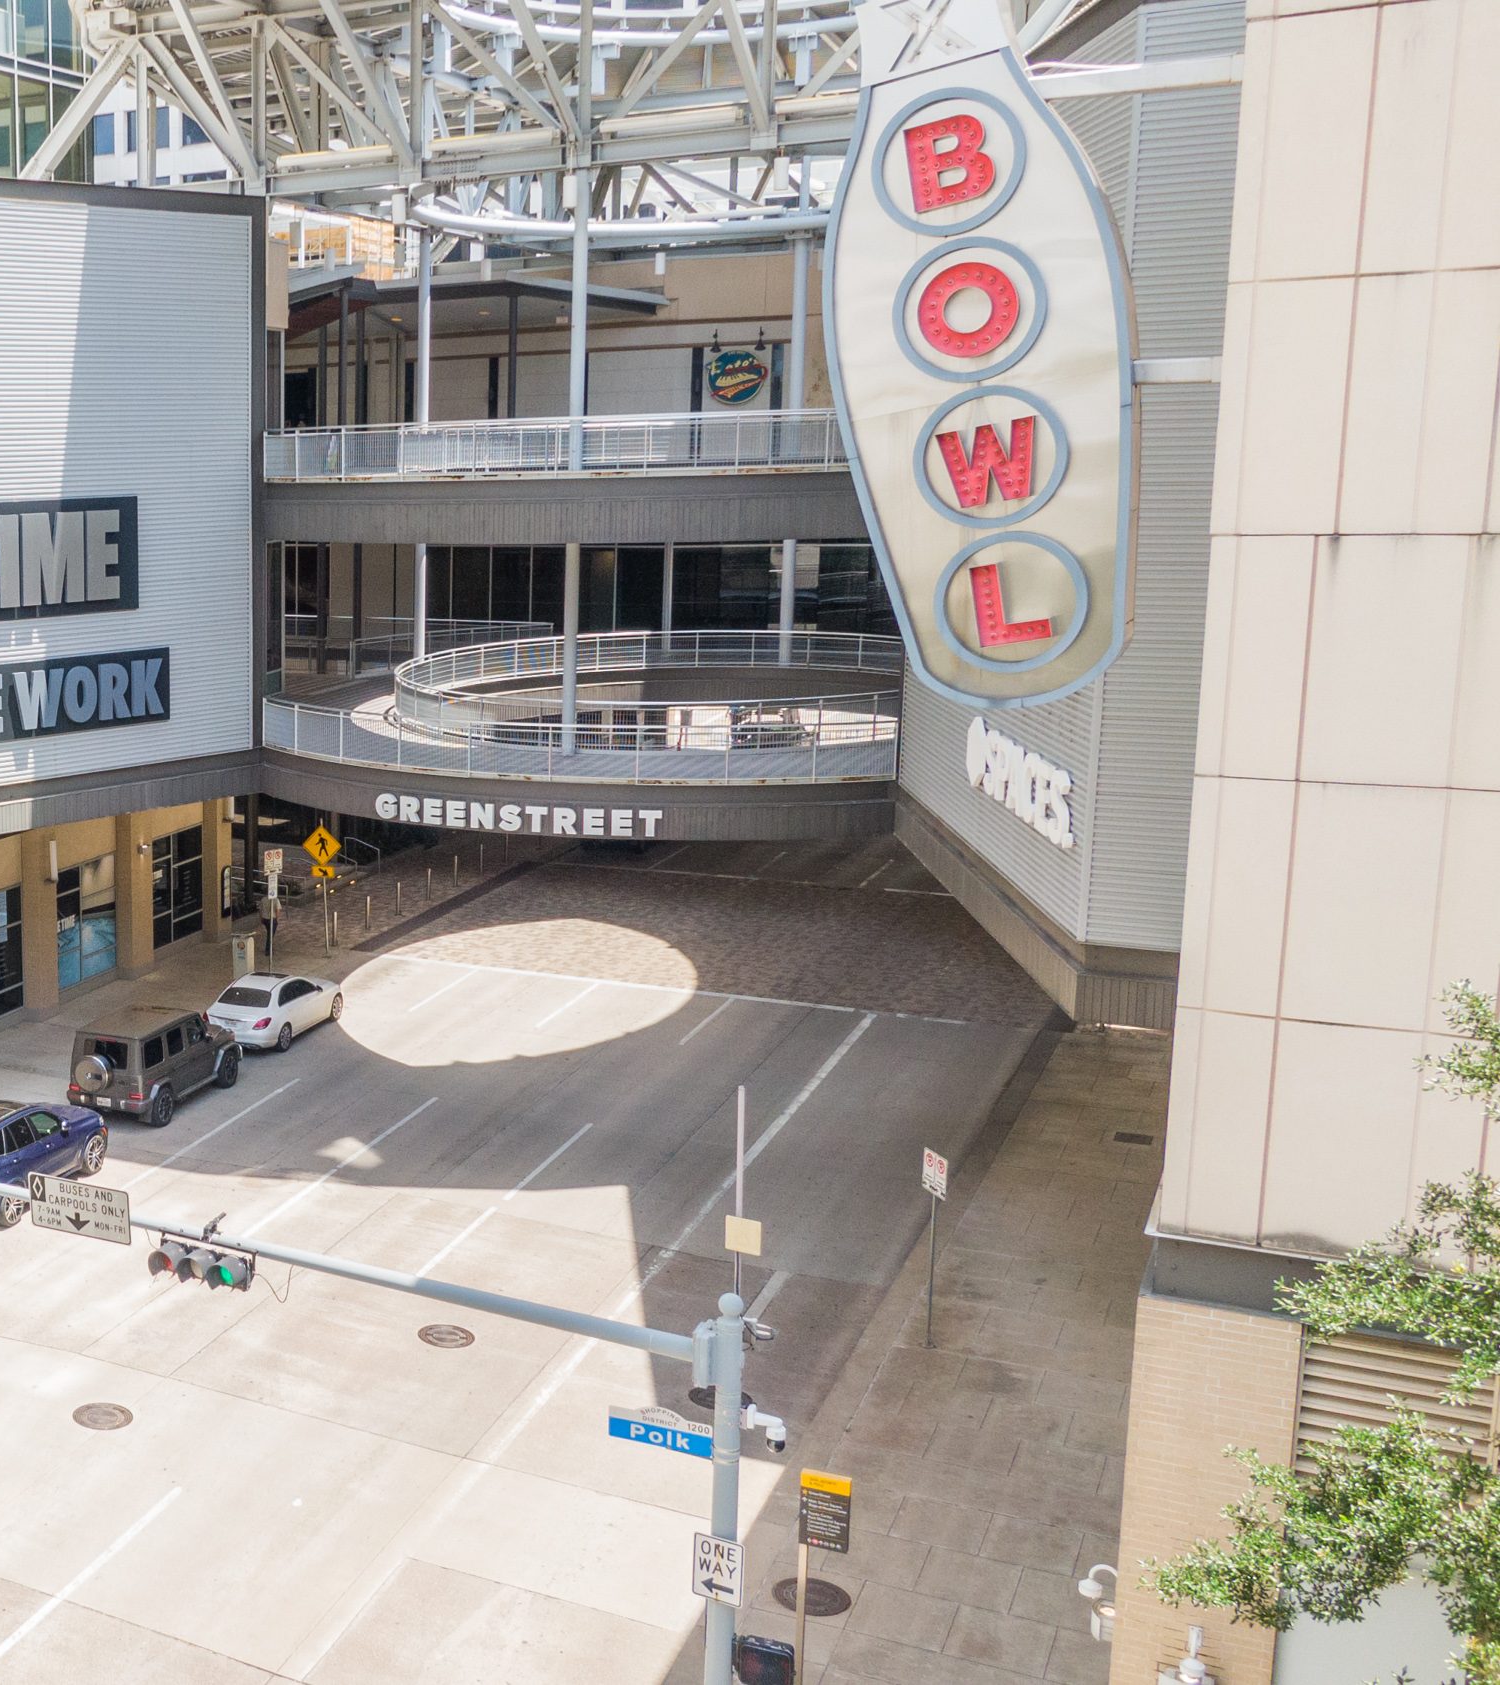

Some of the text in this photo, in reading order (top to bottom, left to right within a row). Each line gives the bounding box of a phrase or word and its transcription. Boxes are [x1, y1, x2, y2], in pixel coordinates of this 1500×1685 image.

[902, 113, 1054, 649] BOWL
[12, 657, 165, 731] WORK
[375, 793, 664, 838] GREENSTREET
[59, 1182, 113, 1202] BUSES AND
[37, 1204, 61, 1216] 7-9AM
[48, 1194, 125, 1218] CARPOOLS ONLY
[38, 1215, 62, 1227] 4-6PM
[94, 1221, 126, 1234] MON-FRI
[630, 1423, 690, 1451] Polk
[687, 1423, 710, 1435] 1200
[700, 1540, 737, 1564] ONE
[699, 1556, 737, 1580] WAY
